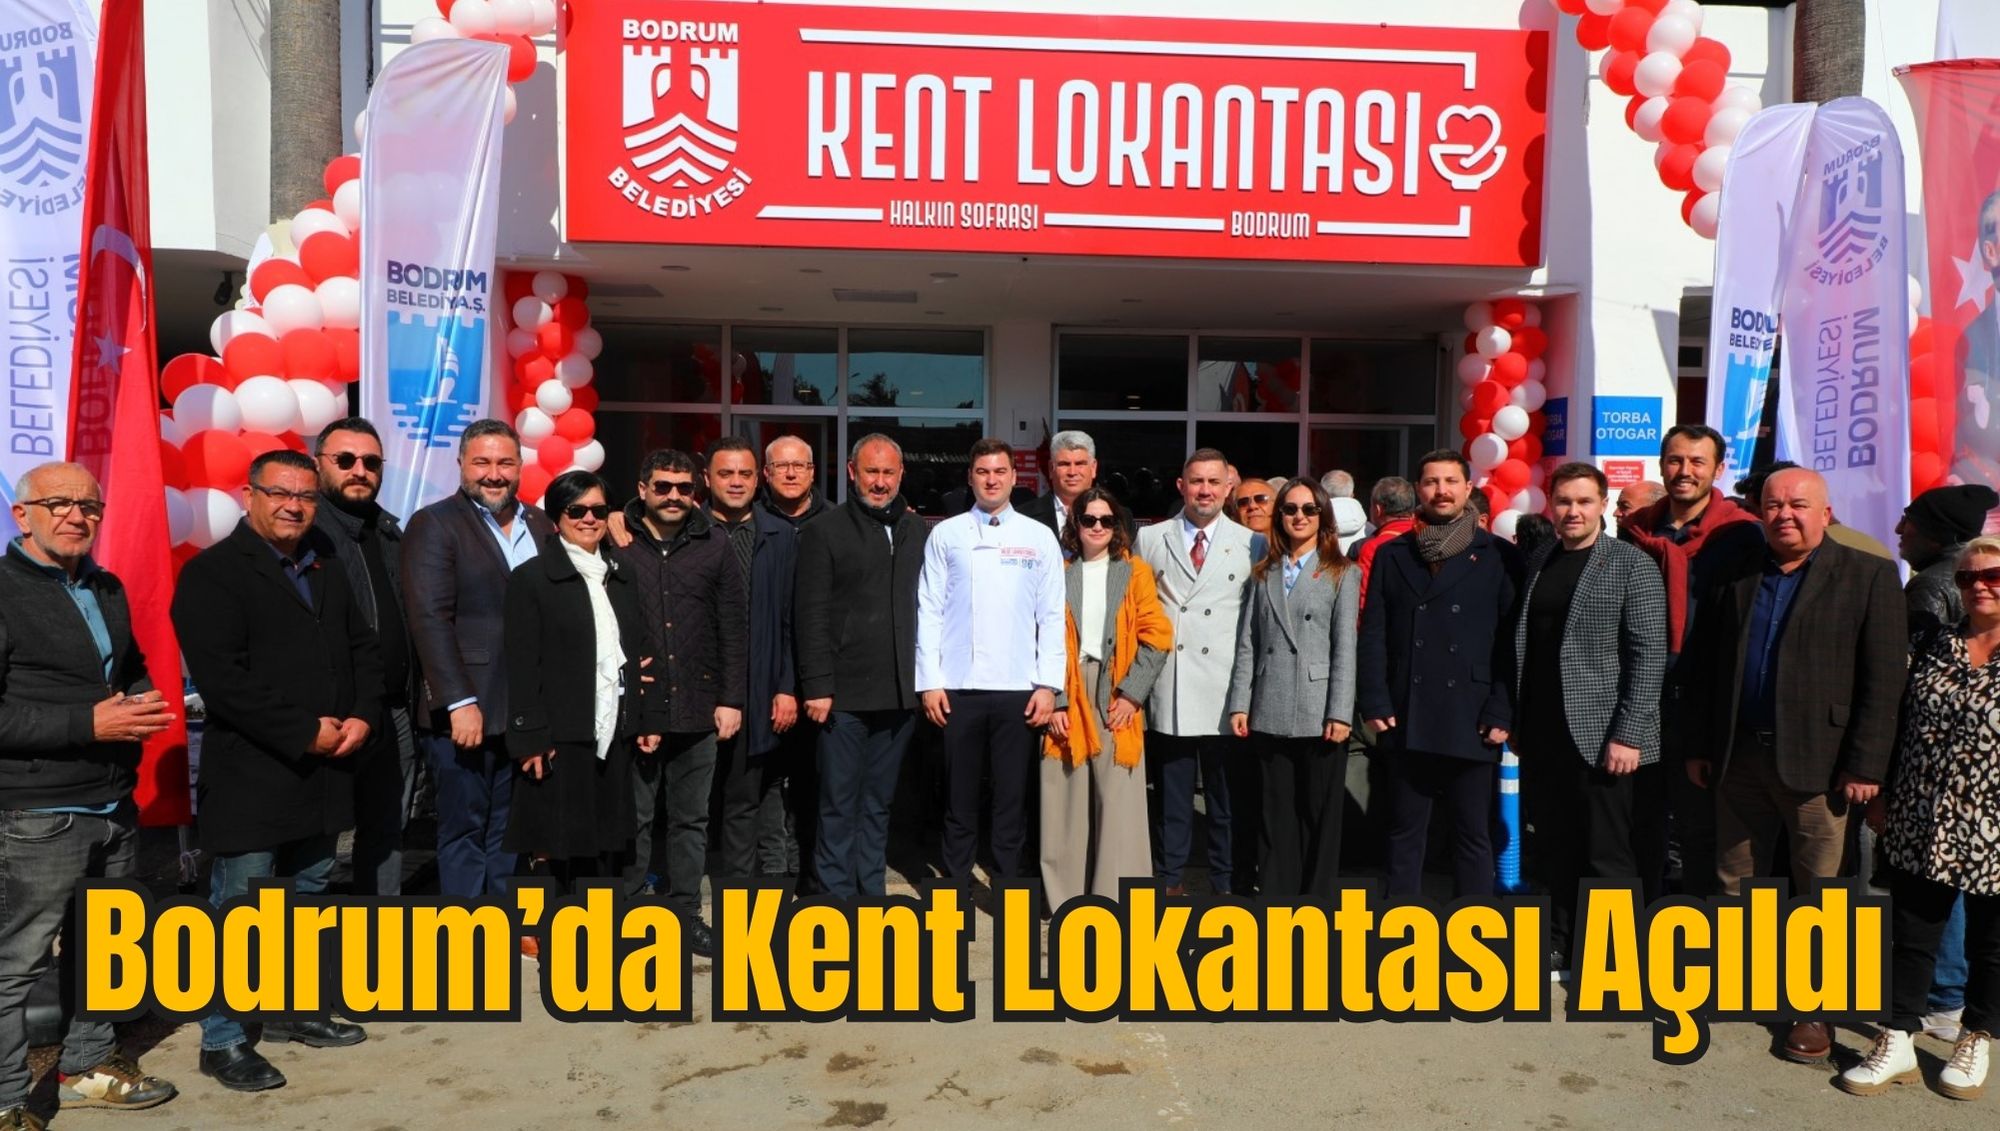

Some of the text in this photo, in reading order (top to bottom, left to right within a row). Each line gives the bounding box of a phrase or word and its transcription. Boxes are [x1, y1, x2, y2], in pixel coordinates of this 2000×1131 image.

[622, 18, 738, 43] BODRUM
[808, 71, 1421, 196] KENT LOKANTASI
[608, 166, 752, 219] BELEDİYESİ
[890, 200, 1310, 239] HALKIN SOFRASI BODRUM
[1595, 427, 1656, 440] OTOGAR
[1602, 411, 1651, 424] TORBA
